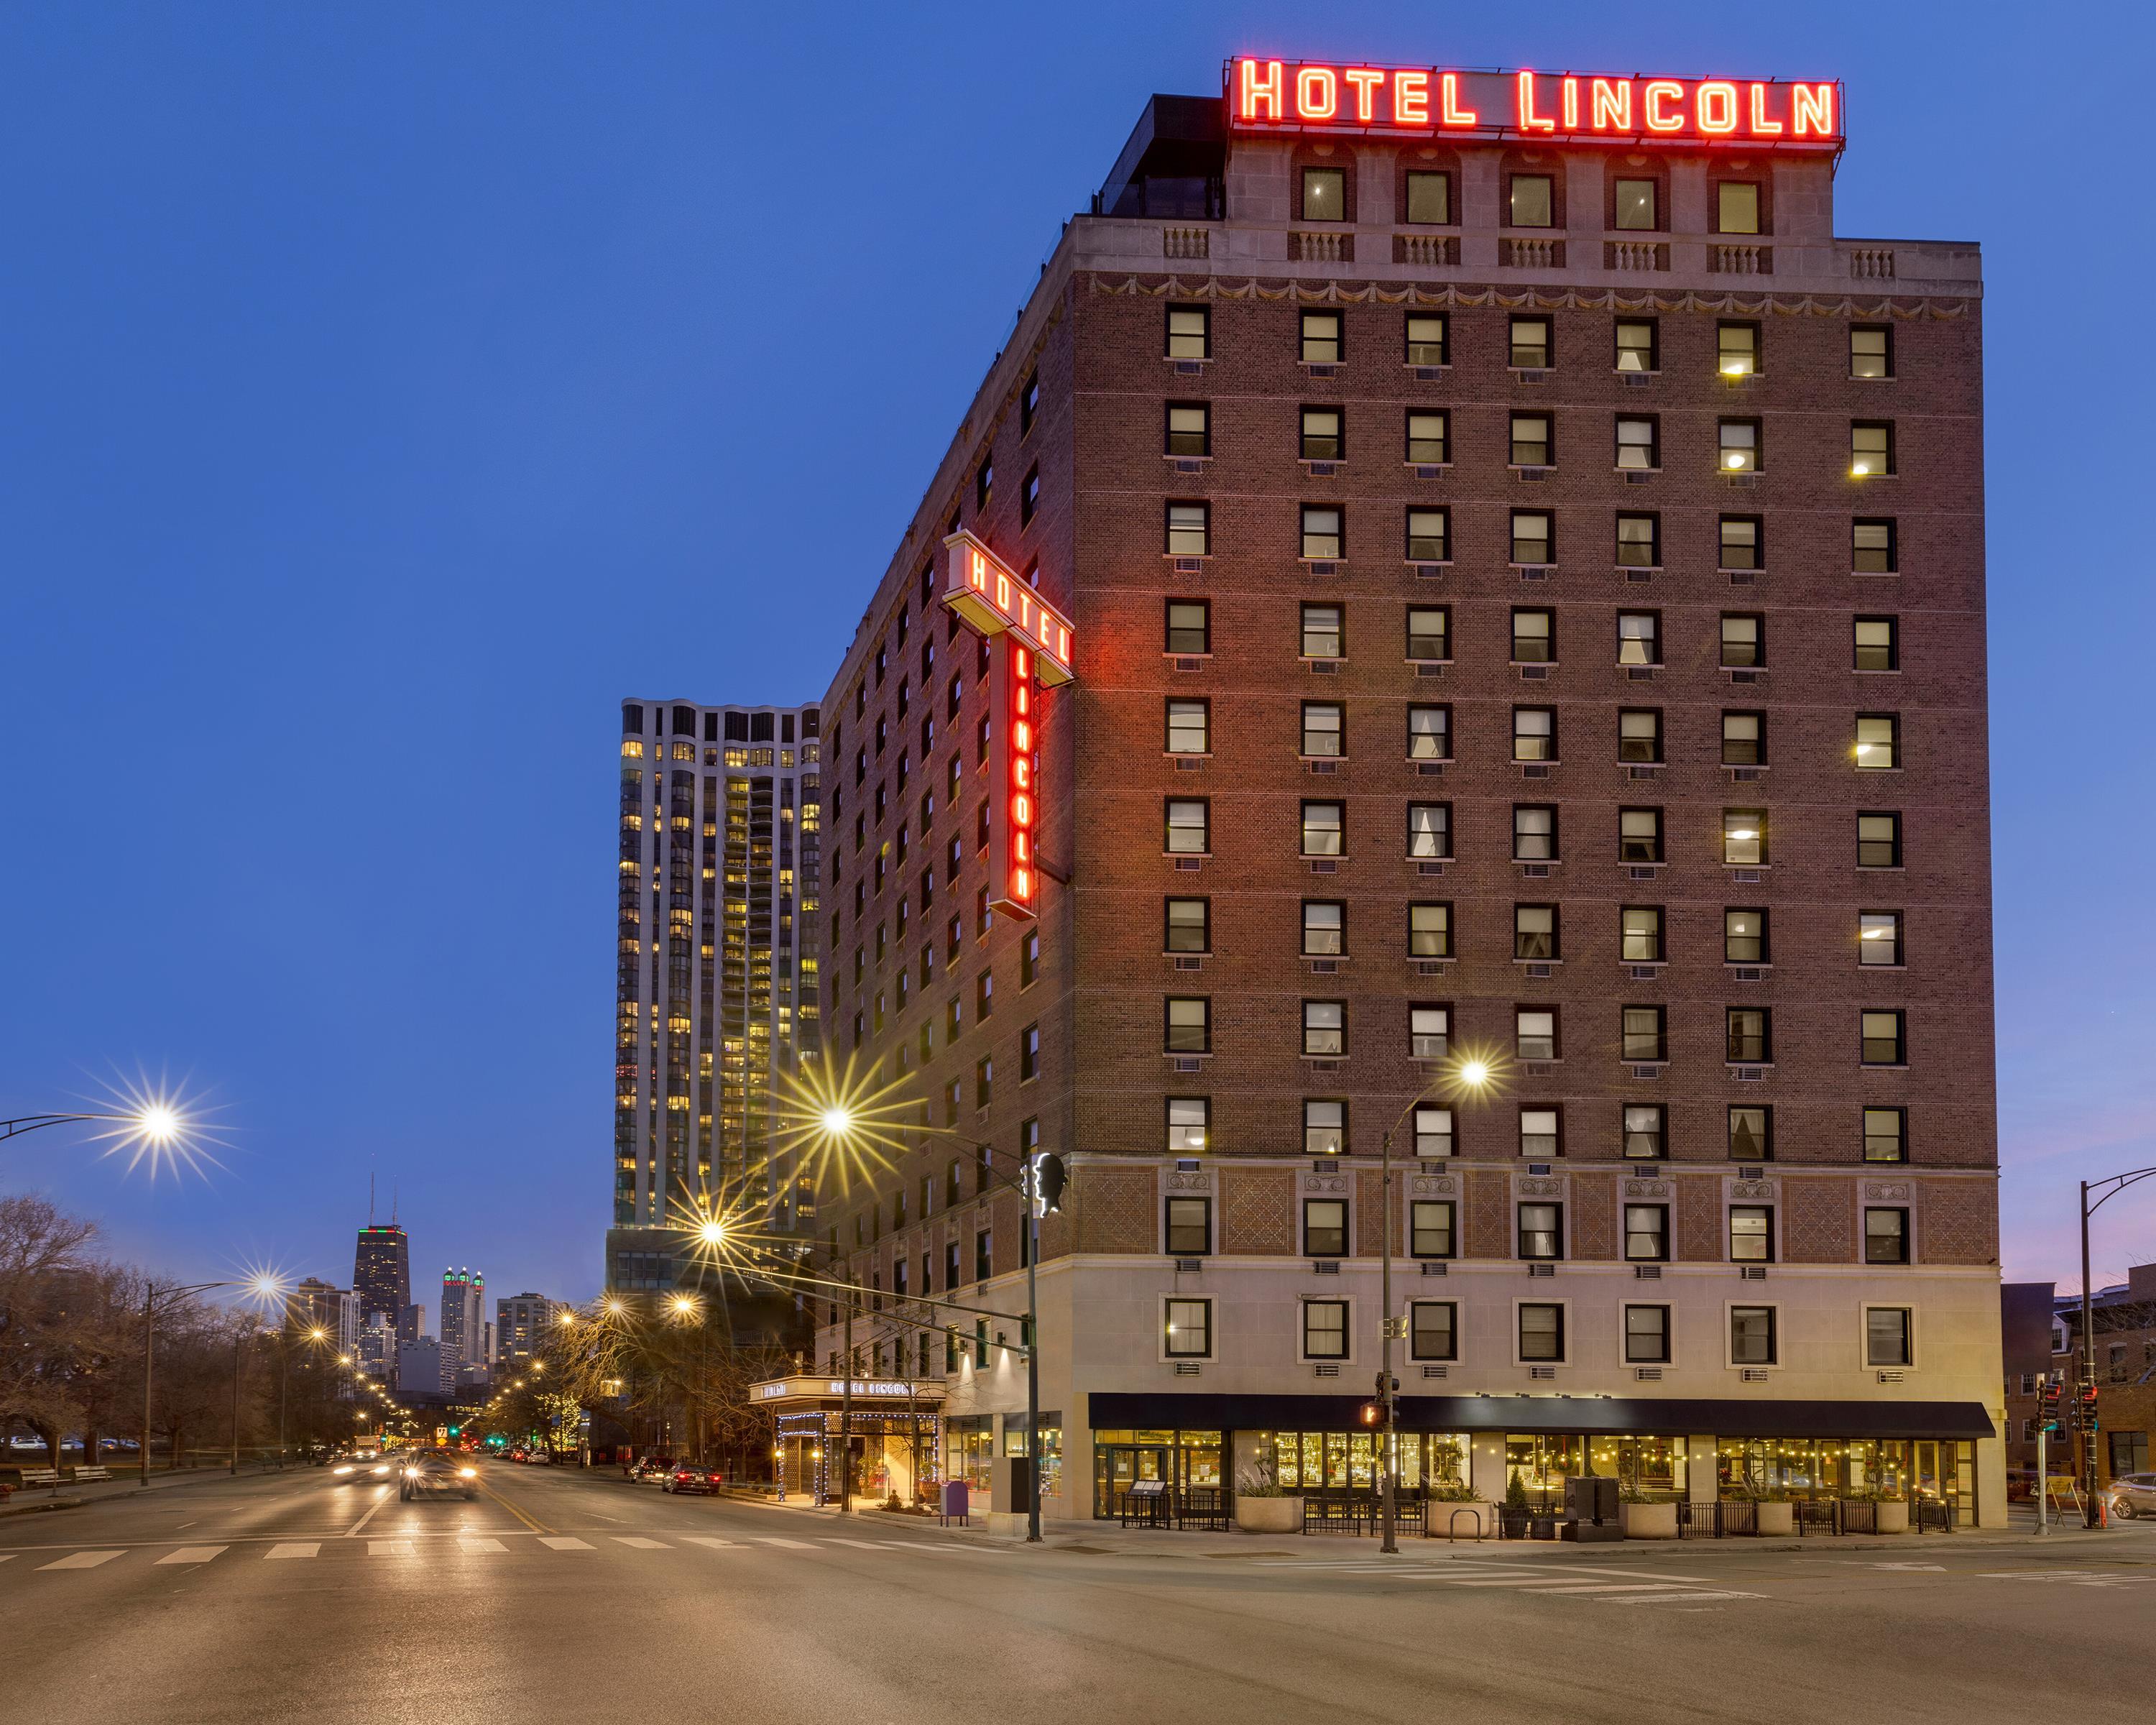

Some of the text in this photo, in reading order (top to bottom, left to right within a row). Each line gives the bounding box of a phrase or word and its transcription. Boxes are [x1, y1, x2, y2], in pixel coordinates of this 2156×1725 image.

[1240, 58, 1834, 136] HOTEL LINCOLN
[972, 551, 1068, 662] HOTEL
[1016, 648, 1028, 898] LINCOLN
[831, 1382, 864, 1393] HOEL
